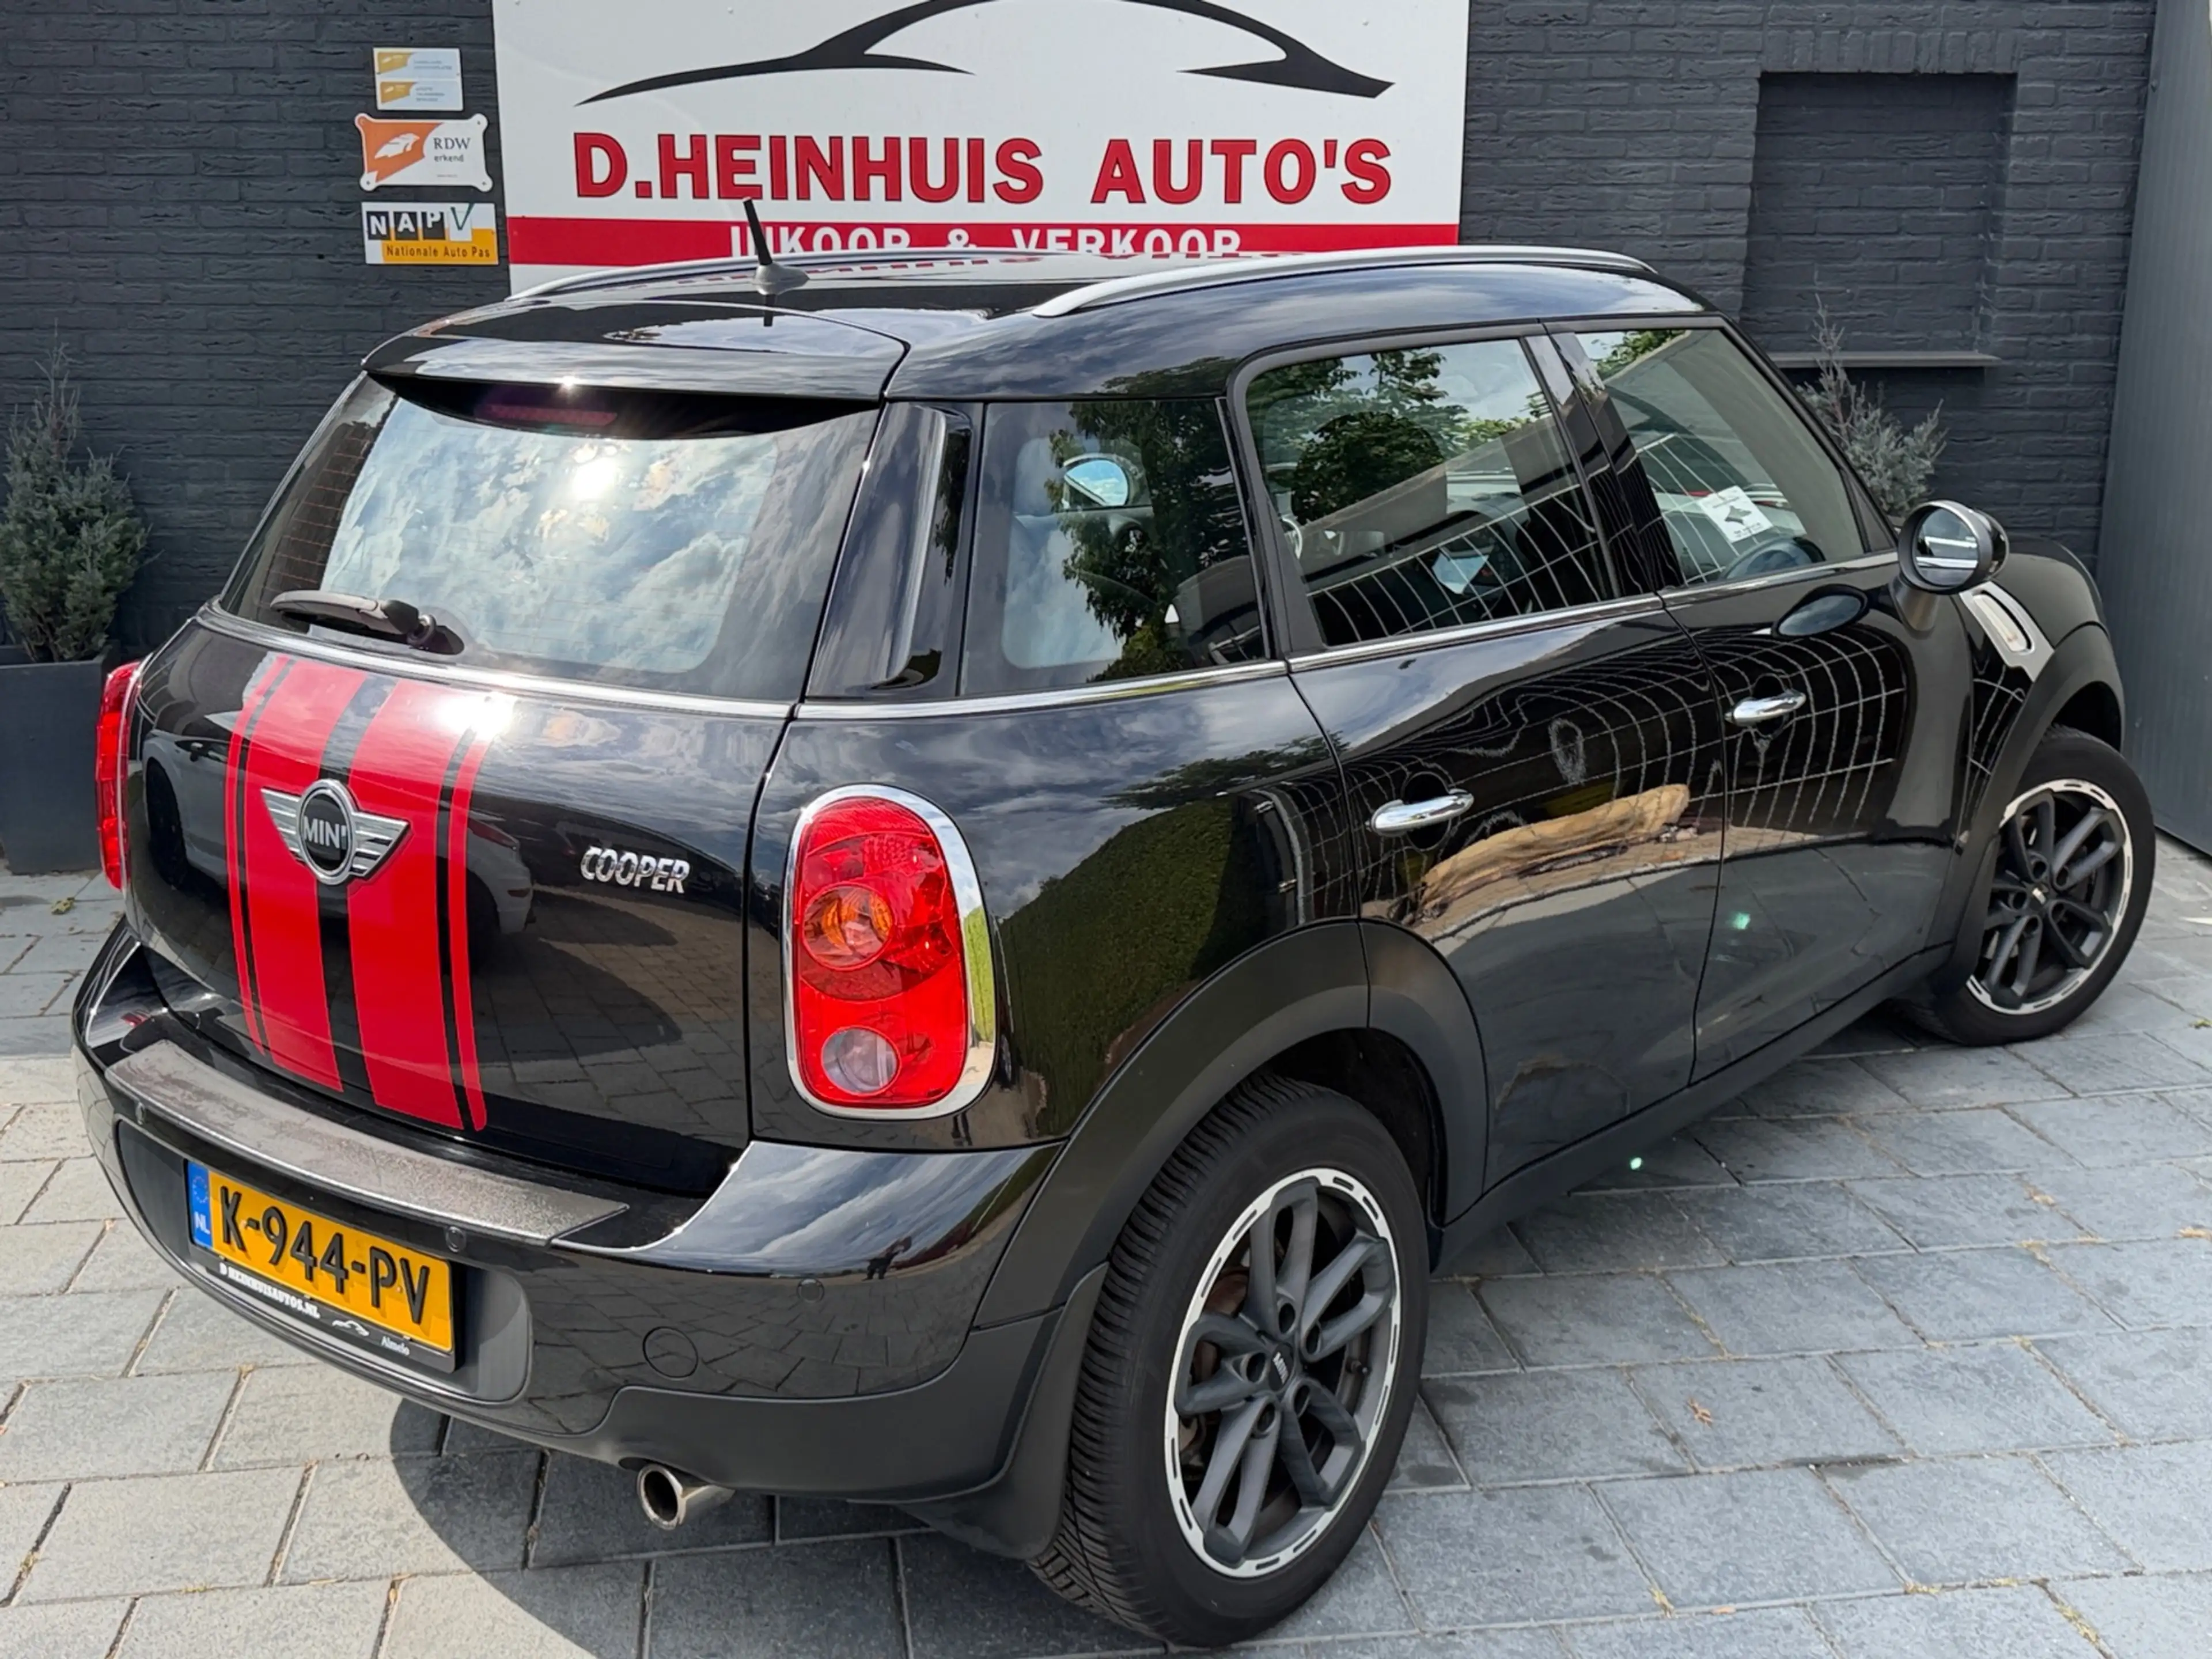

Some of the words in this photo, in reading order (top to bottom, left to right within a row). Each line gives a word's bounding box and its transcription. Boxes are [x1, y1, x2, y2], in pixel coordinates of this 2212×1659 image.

[433, 137, 471, 150] RDW
[434, 154, 464, 162] erkend
[574, 131, 1044, 205] D.HEINHUIS
[1090, 138, 1392, 205] AUTO'S
[946, 228, 978, 248] &
[387, 245, 438, 257] Nationale
[444, 246, 468, 258] Auto
[471, 247, 490, 258] Pas
[304, 815, 347, 850] MINI
[580, 845, 691, 894] COOPER
[194, 1211, 211, 1235] NL
[220, 1185, 430, 1325] K-944-PV
